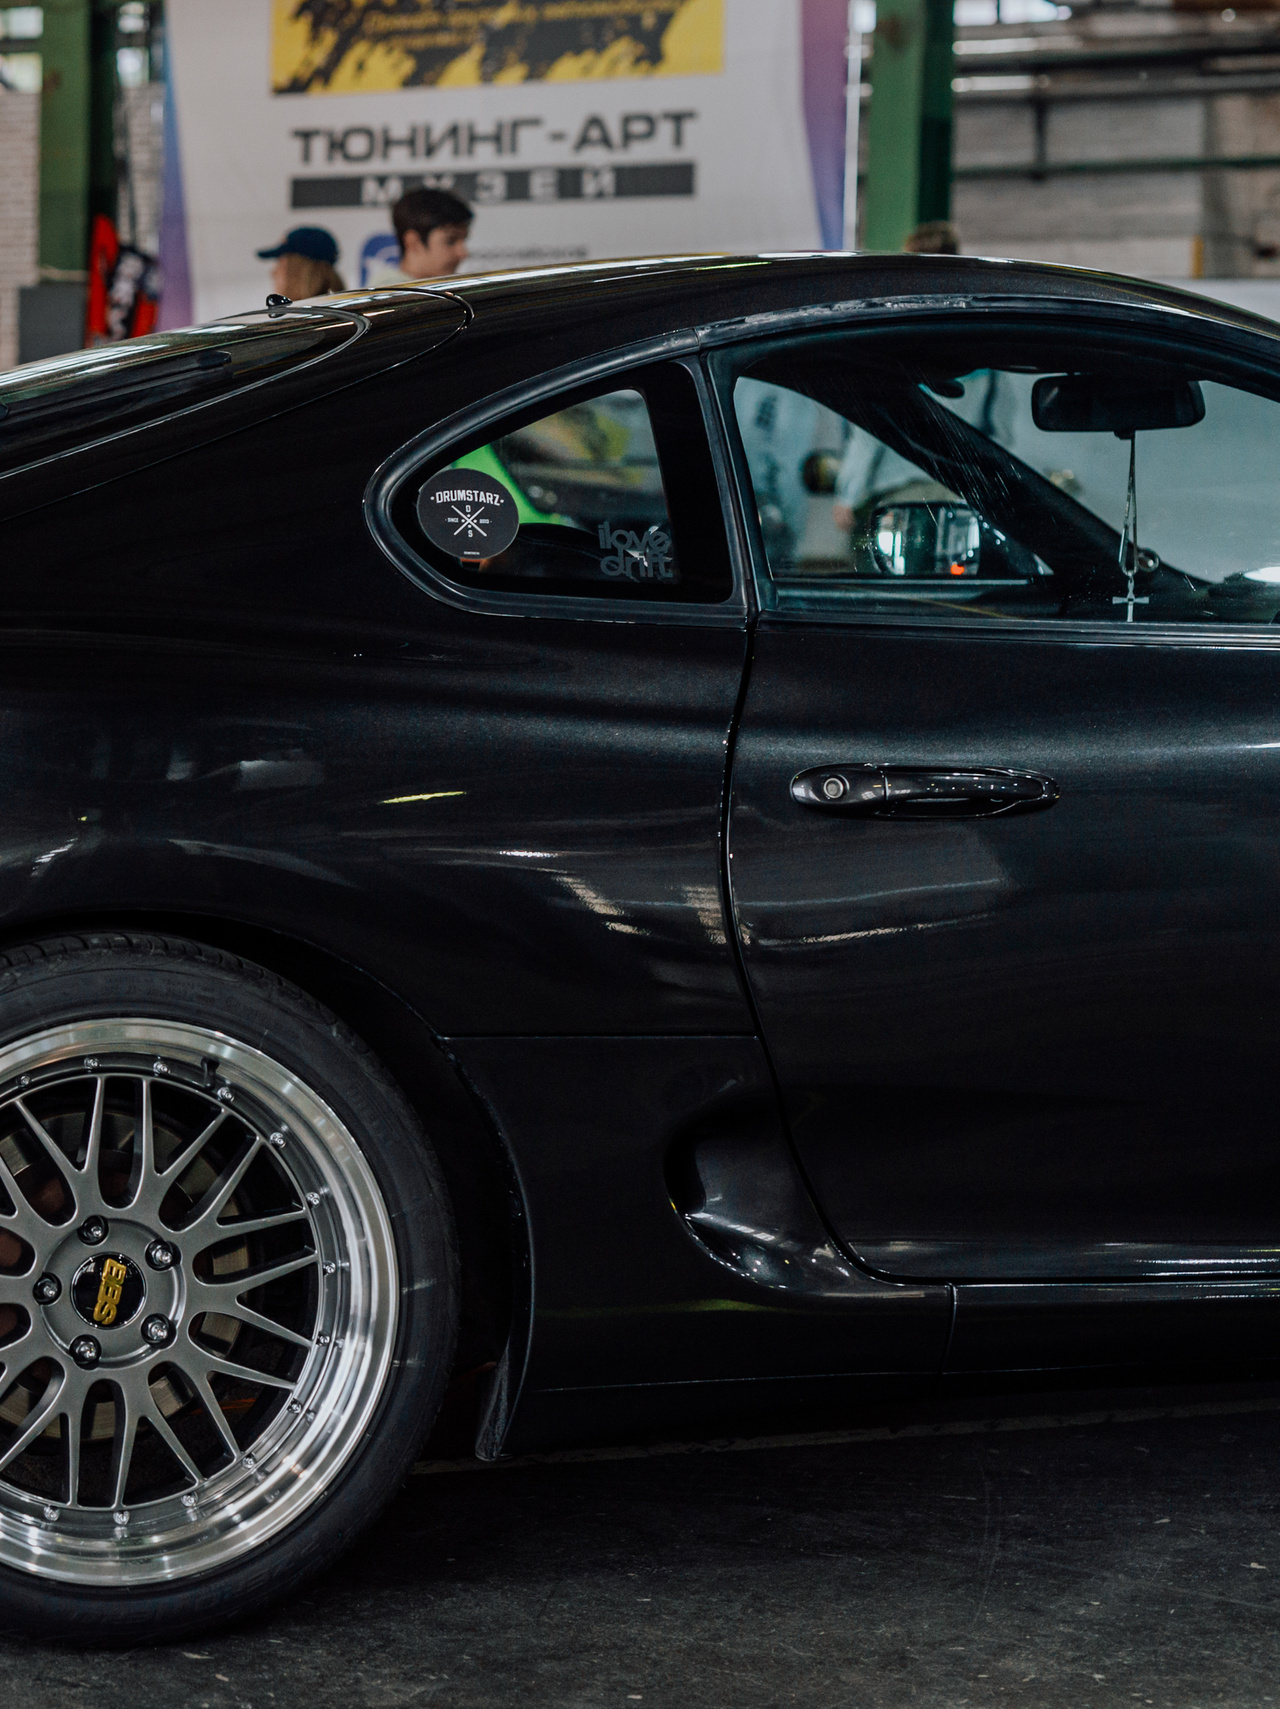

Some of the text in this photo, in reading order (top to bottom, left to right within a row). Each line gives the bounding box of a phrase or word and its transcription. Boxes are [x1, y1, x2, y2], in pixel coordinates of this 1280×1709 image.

[292, 112, 697, 165] ТЮНИНГ-АРТ
[435, 489, 500, 506] DRUMSTARZ
[93, 1258, 127, 1325] BBS
